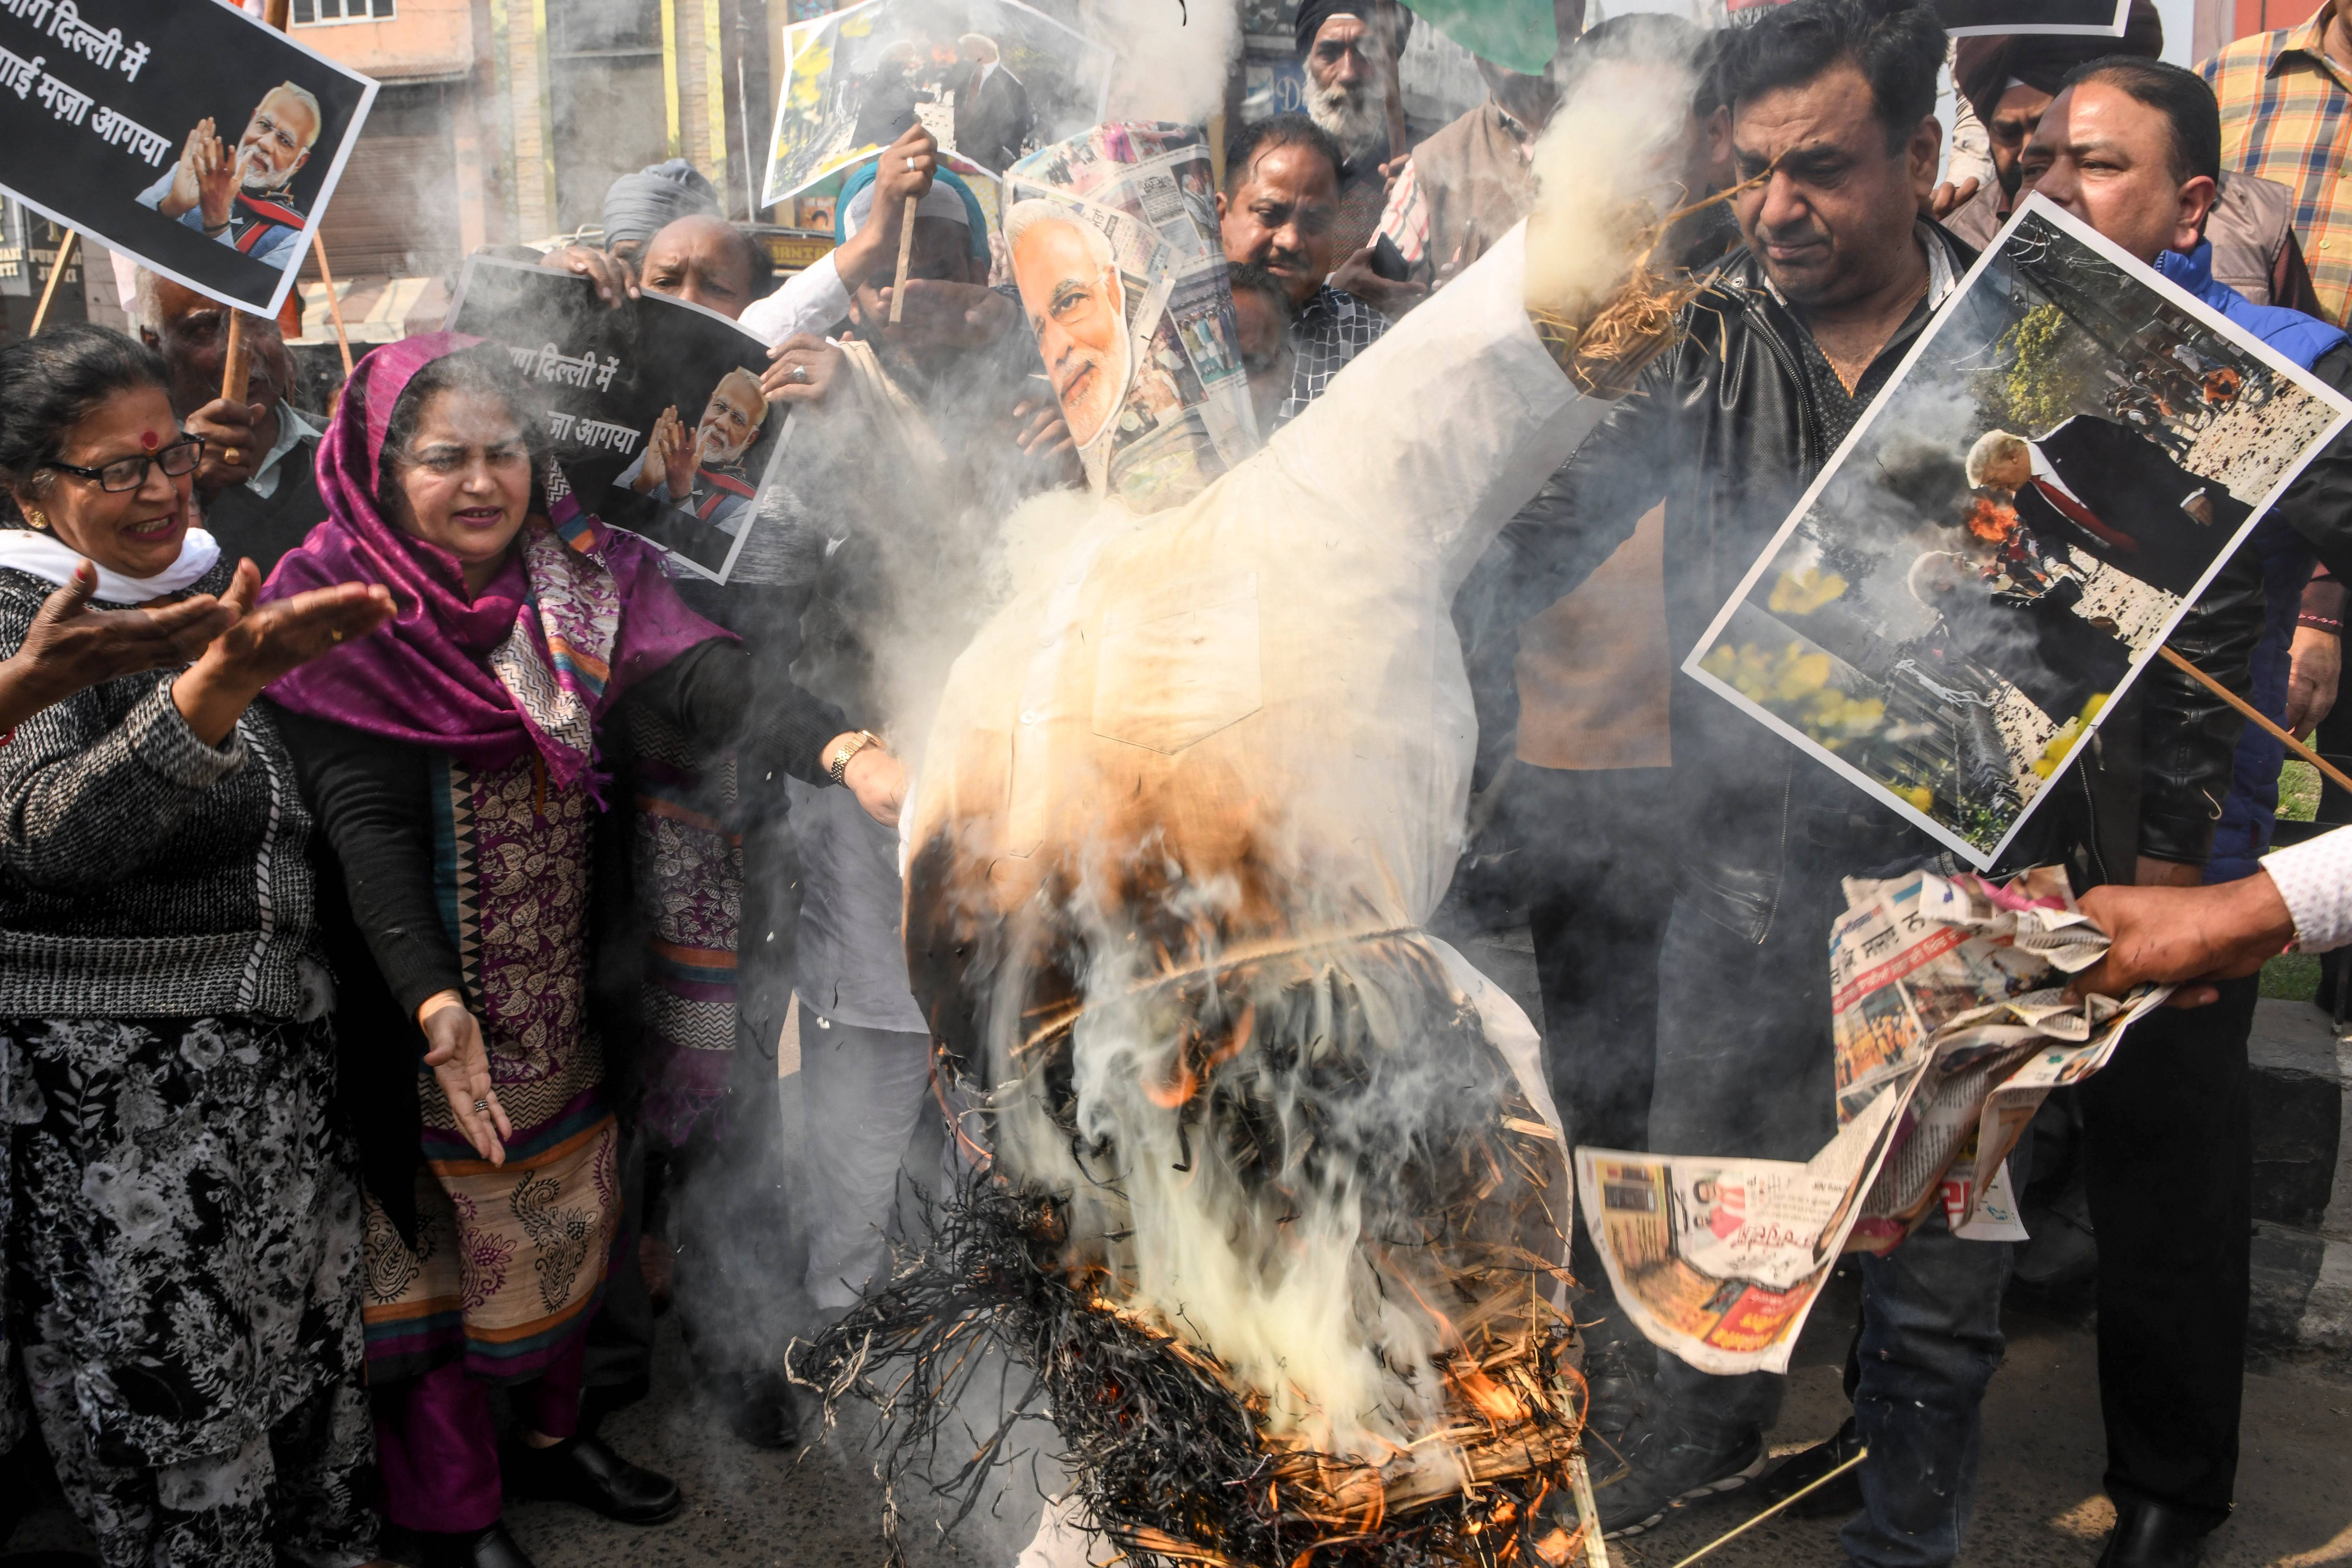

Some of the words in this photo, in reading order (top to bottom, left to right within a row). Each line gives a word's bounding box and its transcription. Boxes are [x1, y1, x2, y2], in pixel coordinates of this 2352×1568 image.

[46, 0, 124, 70] दिल्ली
[120, 41, 151, 82] में
[37, 72, 95, 126] मज़ा
[91, 106, 173, 167] आगया
[534, 343, 597, 388] दिल्ली
[596, 356, 620, 392] में
[575, 418, 641, 454] आगया
